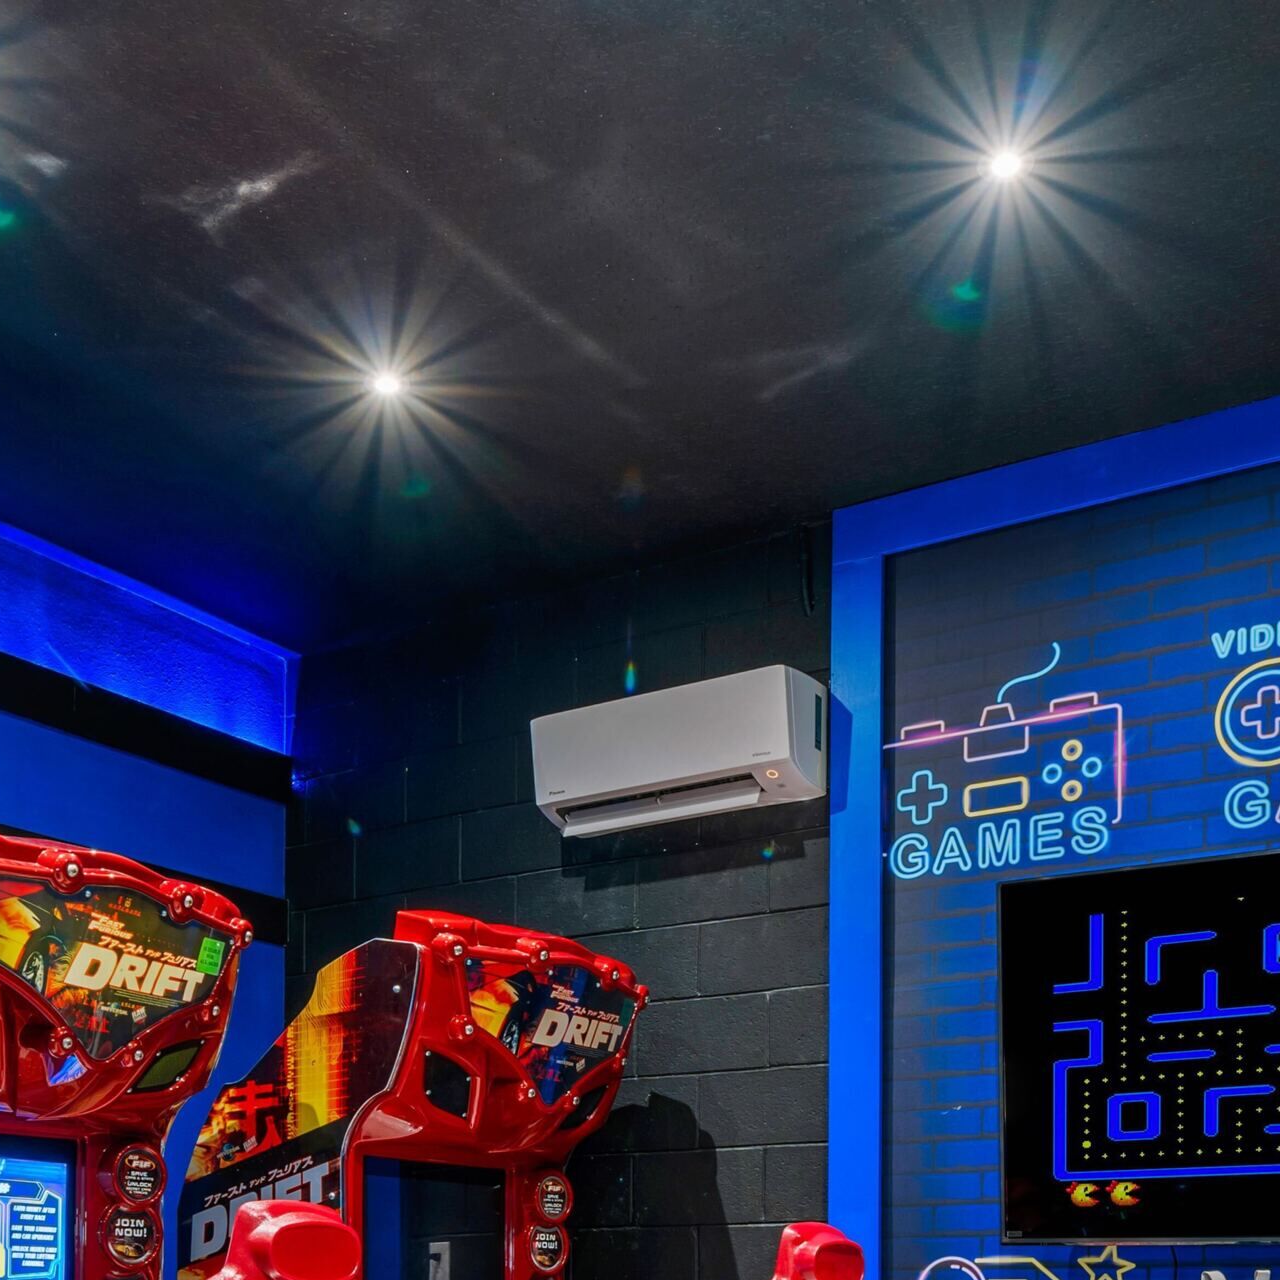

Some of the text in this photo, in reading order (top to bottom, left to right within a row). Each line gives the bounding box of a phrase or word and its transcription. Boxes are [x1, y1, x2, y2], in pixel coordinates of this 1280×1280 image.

[890, 806, 1109, 879] GAMES
[64, 942, 205, 1002] DRIFT
[532, 1009, 623, 1052] DRIFT
[115, 1218, 145, 1227] JOIN
[115, 1227, 147, 1237] NOW!
[535, 1233, 556, 1241] JOIN
[535, 1241, 558, 1249] NOW!
